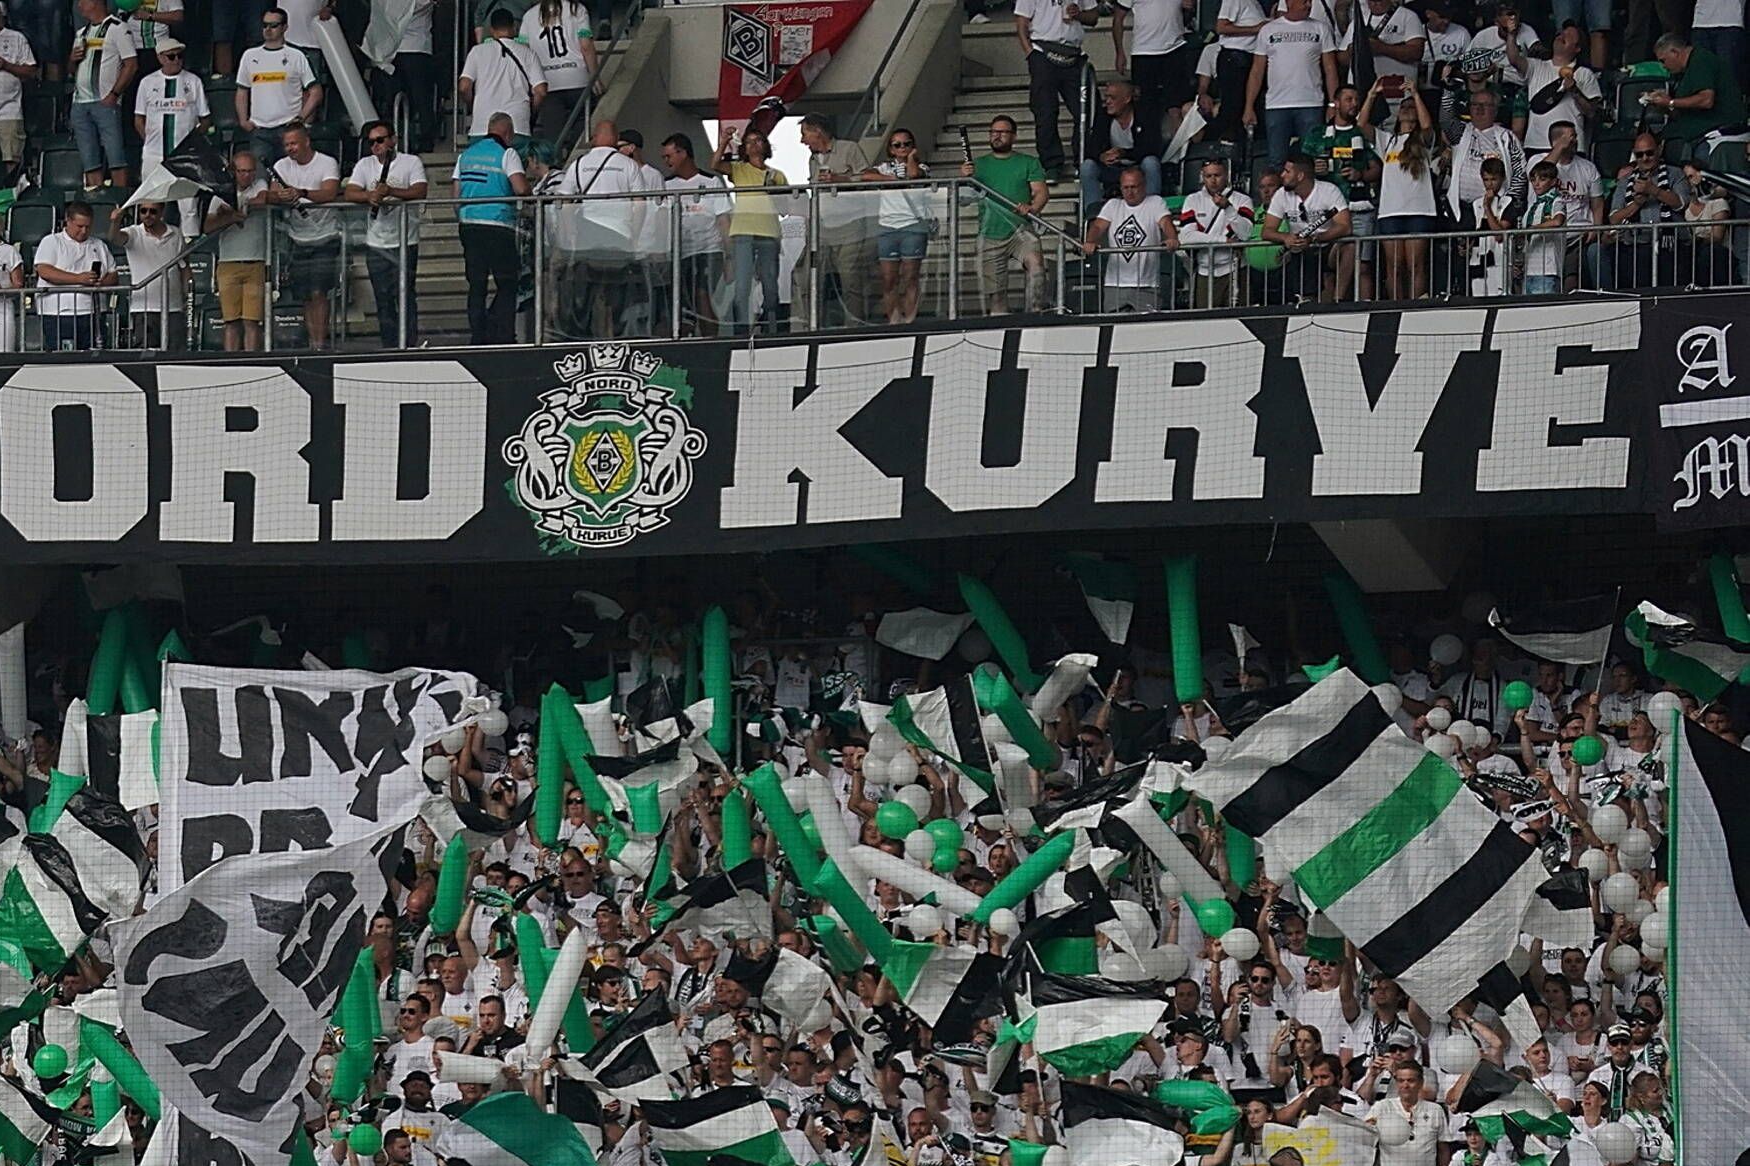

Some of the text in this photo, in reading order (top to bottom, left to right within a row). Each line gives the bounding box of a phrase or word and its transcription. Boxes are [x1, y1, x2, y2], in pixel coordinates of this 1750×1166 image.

[539, 25, 567, 58] 10
[583, 378, 633, 391] NORD
[719, 301, 1640, 529] KURVE
